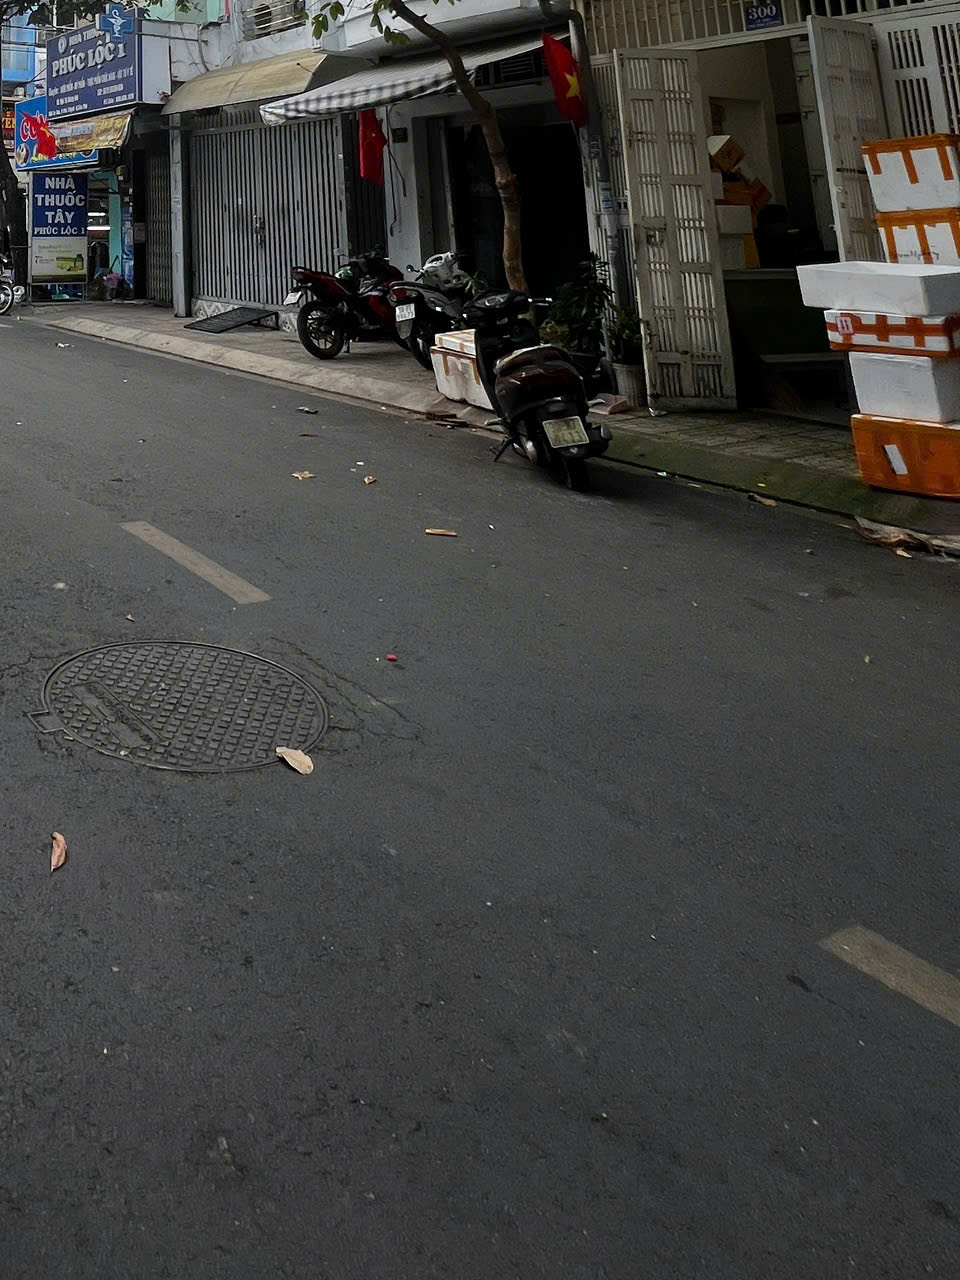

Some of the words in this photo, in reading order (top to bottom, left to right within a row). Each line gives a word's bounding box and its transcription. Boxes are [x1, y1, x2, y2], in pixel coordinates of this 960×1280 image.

[748, 4, 777, 20] 300
[51, 48, 86, 78] PHÚC
[87, 40, 116, 69] LỘC
[45, 175, 75, 189] NHÀ
[35, 190, 85, 206] THUỐC
[45, 208, 75, 224] TÂY
[34, 226, 59, 235] PHÚC
[60, 225, 78, 236] LỘC
